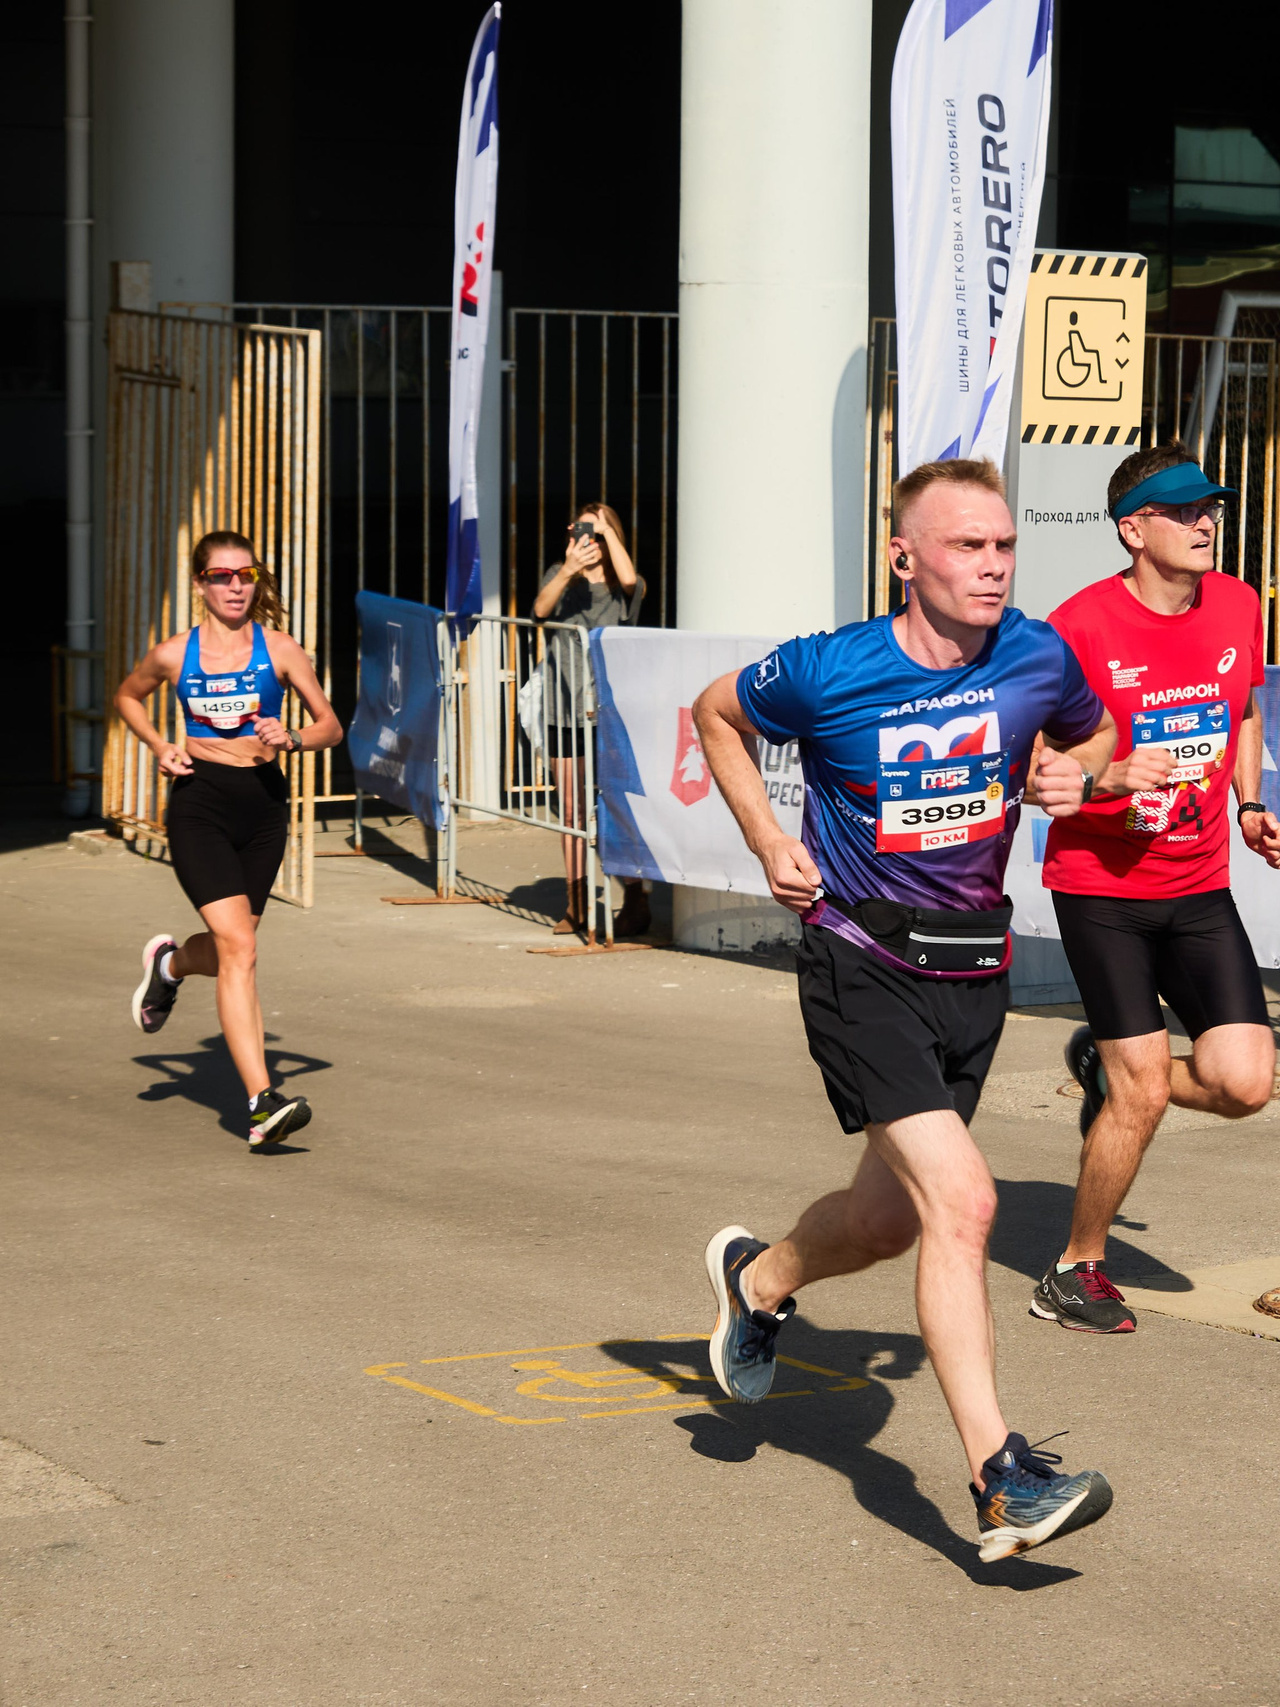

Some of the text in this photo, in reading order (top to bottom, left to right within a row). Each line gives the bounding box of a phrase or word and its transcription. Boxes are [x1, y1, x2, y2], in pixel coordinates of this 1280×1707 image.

[944, 98, 970, 393] ШИНЫ ДЛЯ ЛЕГКОВЫХ АВТОМОБИЛЕЙ
[1025, 508, 1073, 525] Проход
[1075, 511, 1100, 524] для
[880, 687, 996, 718] МАРАФОН
[1142, 683, 1219, 707] МАРАФОН
[202, 700, 246, 713] 1459
[1165, 742, 1212, 759] 190
[901, 799, 986, 826] 3998
[924, 832, 966, 846] 10 KM
